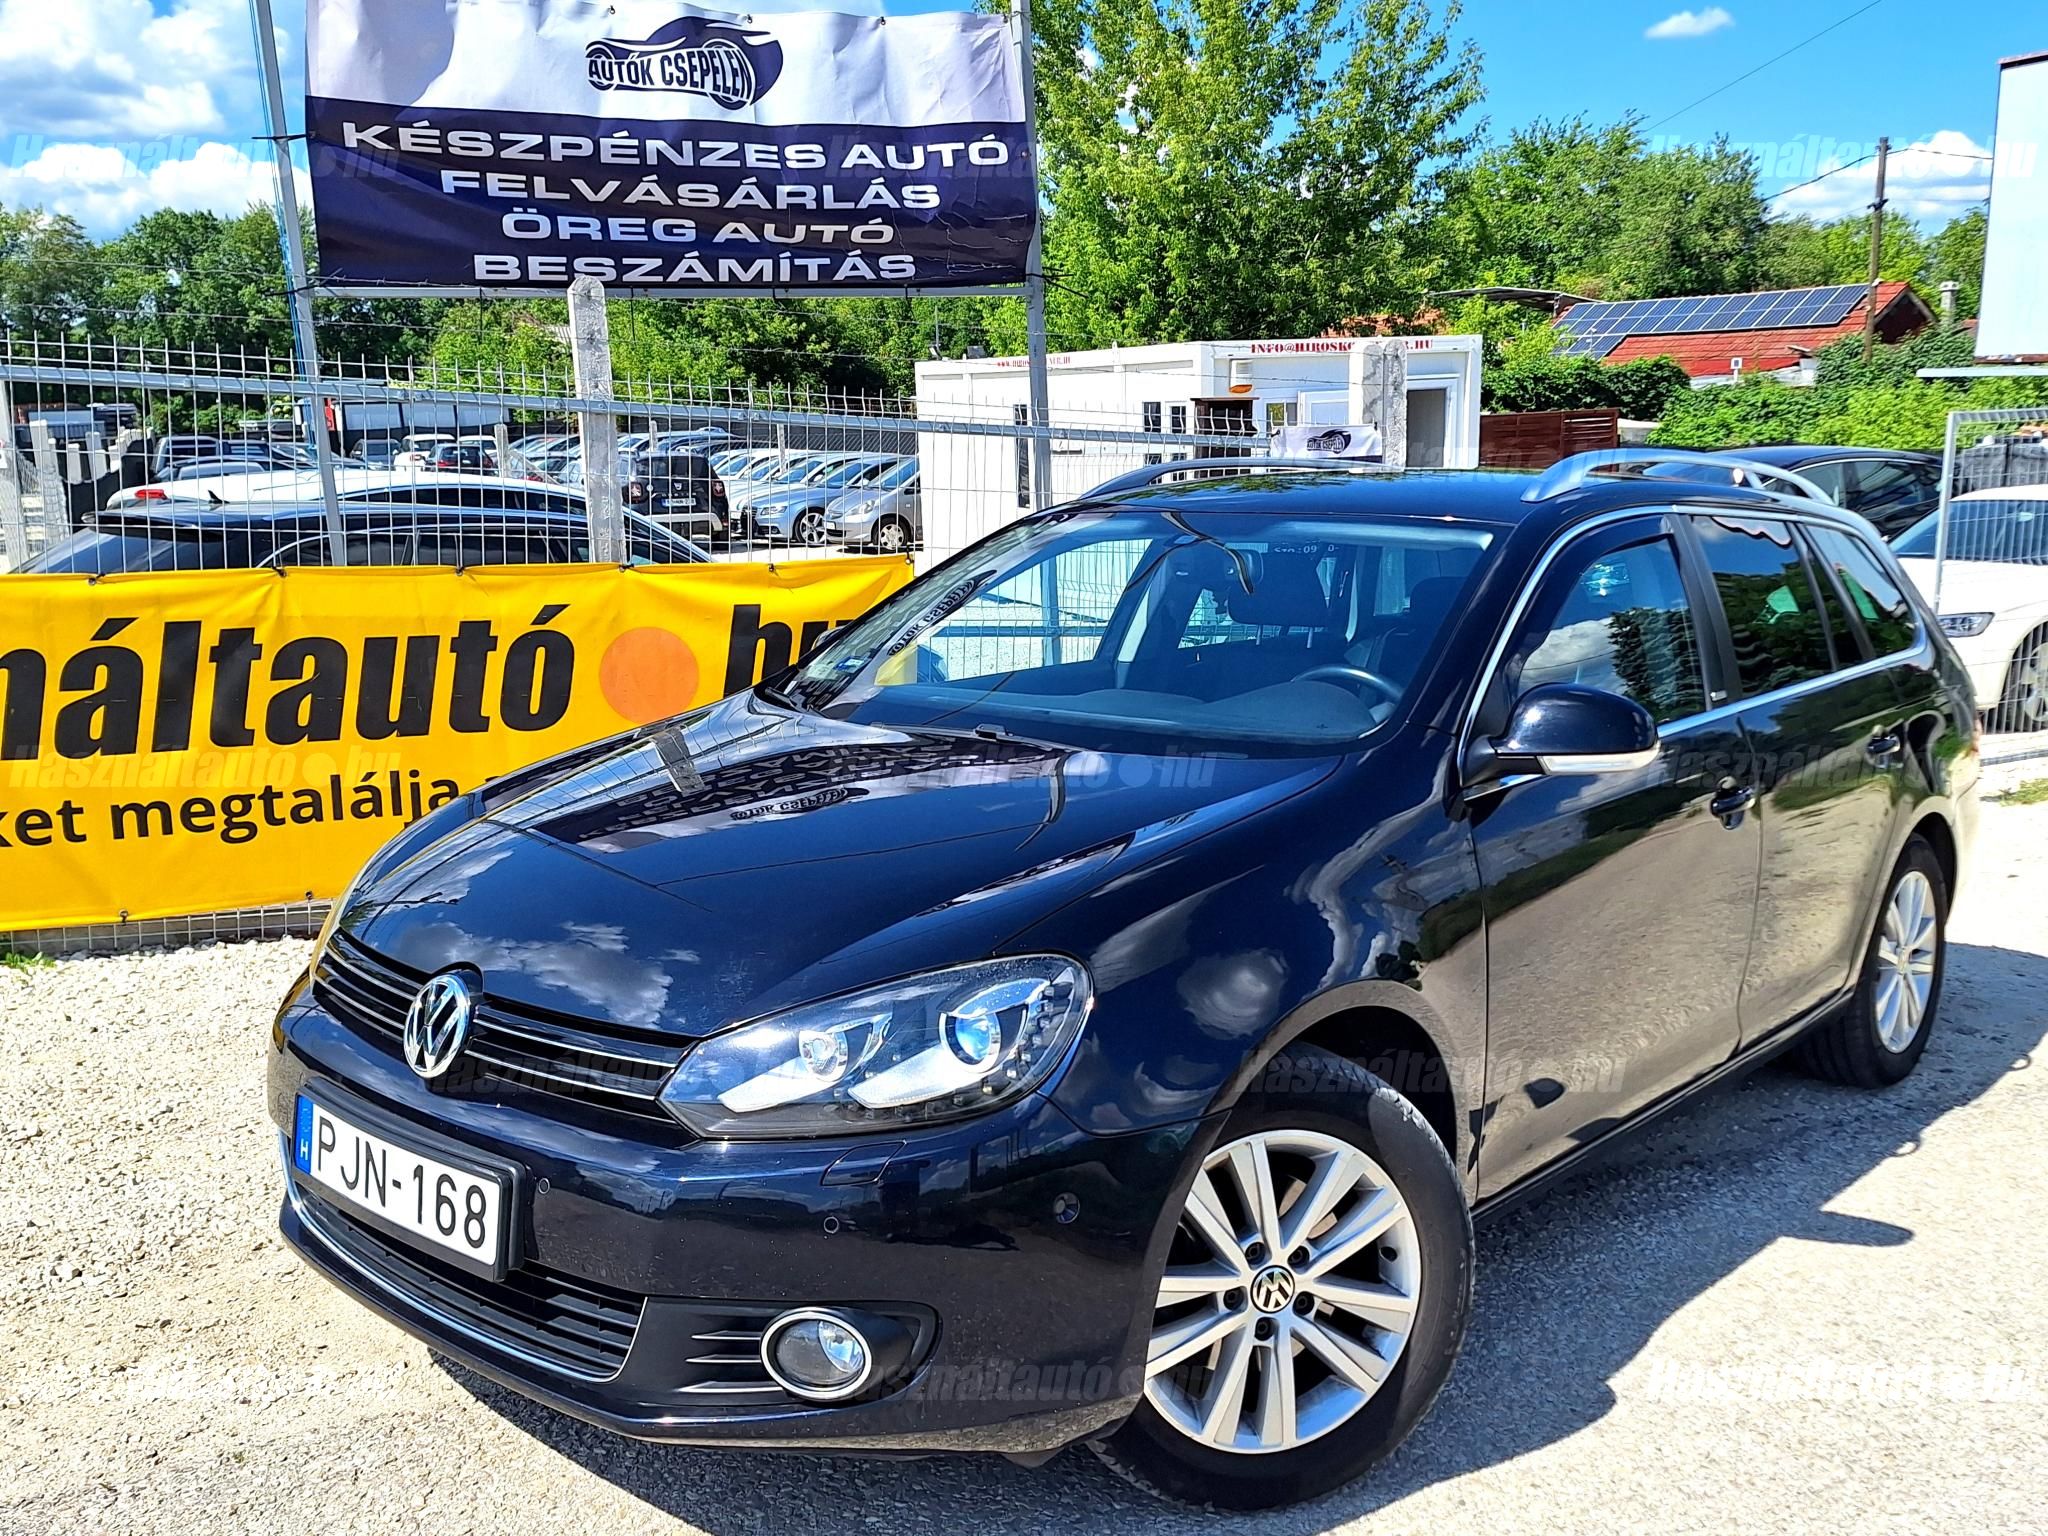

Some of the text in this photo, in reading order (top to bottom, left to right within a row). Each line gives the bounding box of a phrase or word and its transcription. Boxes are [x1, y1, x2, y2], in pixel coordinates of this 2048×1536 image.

[589, 49, 750, 100] AUTÓK CSEPELEN
[342, 119, 1009, 170] KÉSZPÉNZES AUTÓ
[440, 169, 941, 210] FELVÁSÁRLÁS
[502, 206, 894, 245] ÖREG AUTÓ
[474, 250, 916, 283] BESZÁMÍTÁS
[110, 768, 460, 845] megtalálja
[319, 1117, 486, 1249] PJN-168
